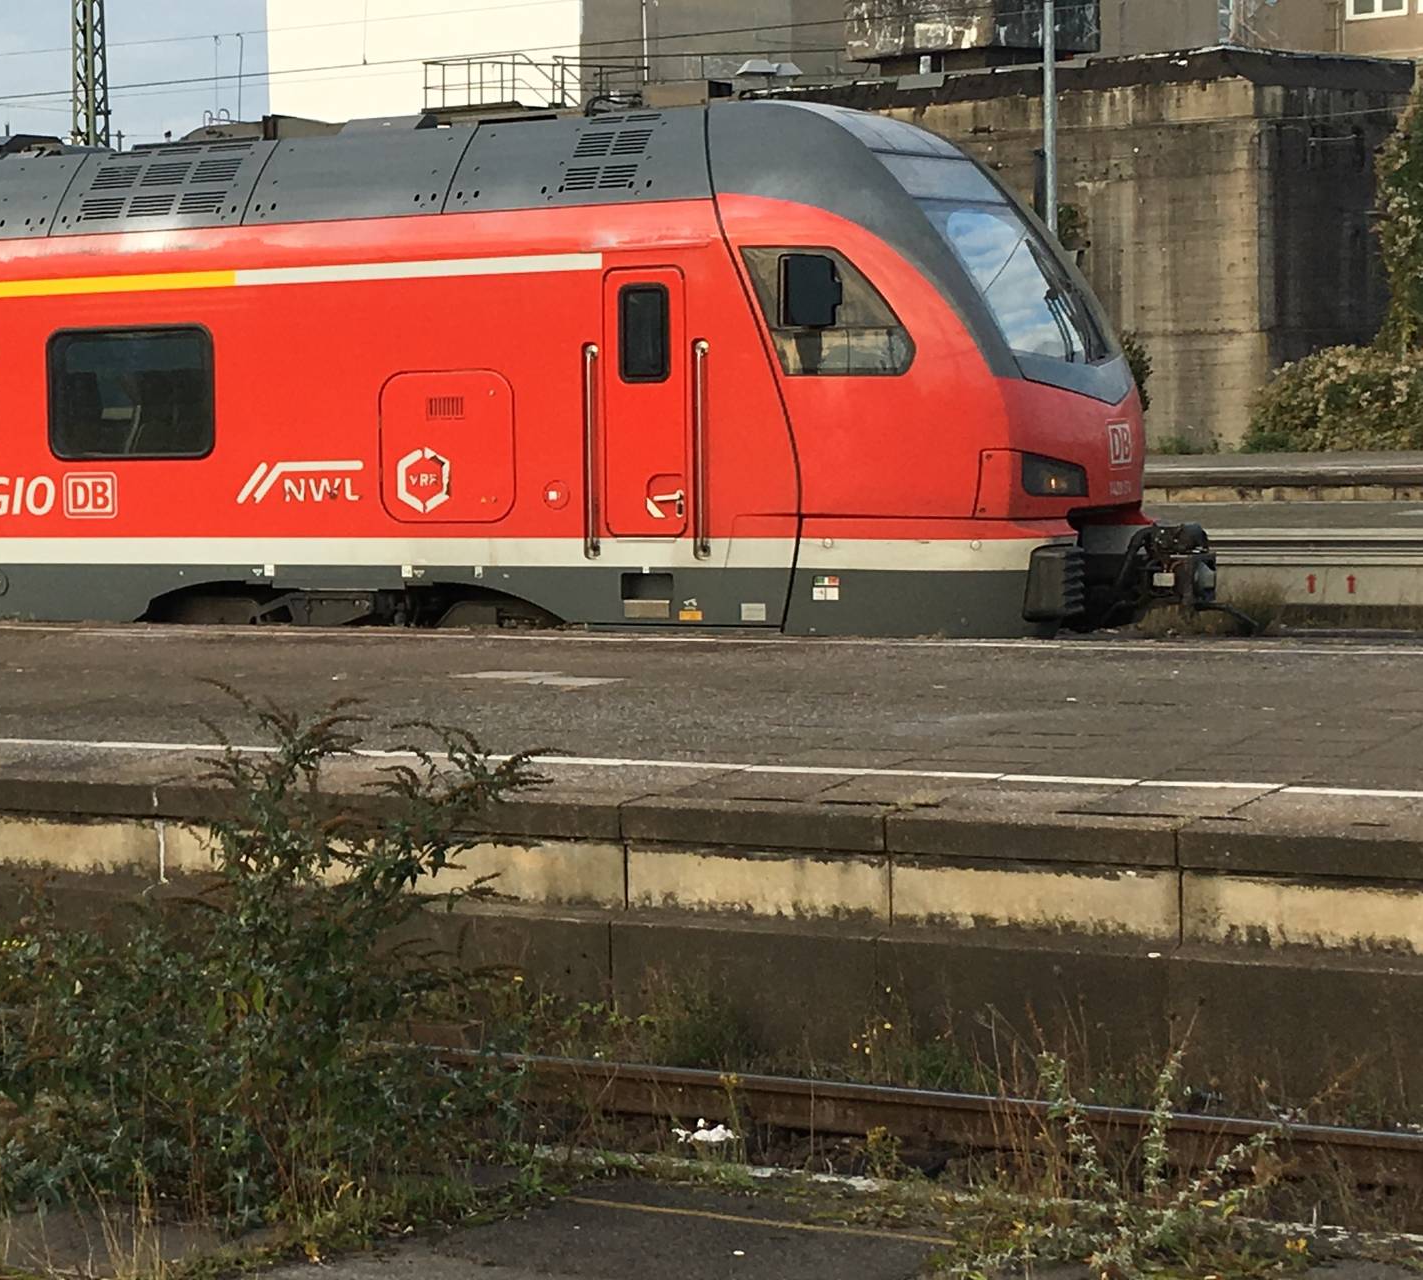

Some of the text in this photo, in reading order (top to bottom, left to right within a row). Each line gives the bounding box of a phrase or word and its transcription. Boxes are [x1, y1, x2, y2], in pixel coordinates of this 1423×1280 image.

[1109, 426, 1131, 462] DB
[70, 480, 112, 511] DB
[283, 477, 361, 502] NWL
